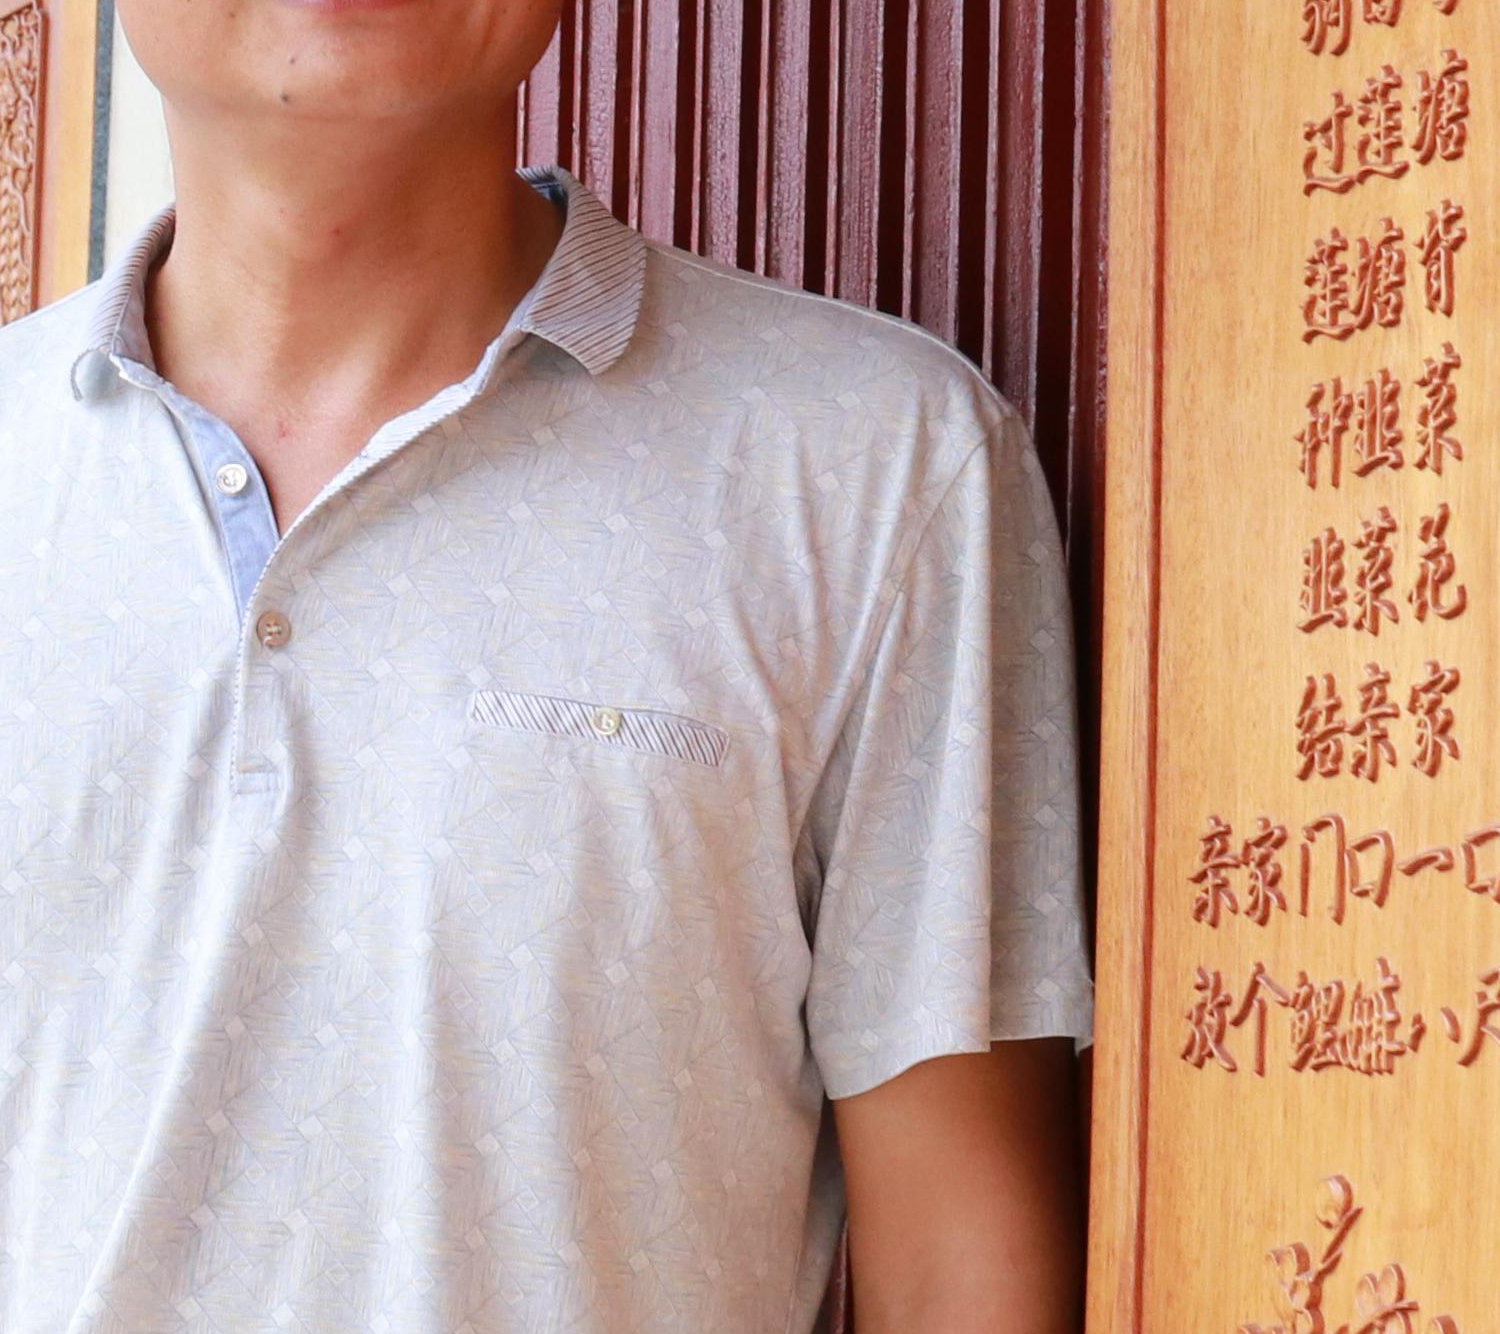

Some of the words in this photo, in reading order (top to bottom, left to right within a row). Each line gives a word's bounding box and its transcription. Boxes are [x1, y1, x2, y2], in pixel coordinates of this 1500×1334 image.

[1295, 340, 1463, 489] 种韭菜
[1296, 502, 1468, 637] 韭菜花
[1296, 659, 1461, 784] 结亲家
